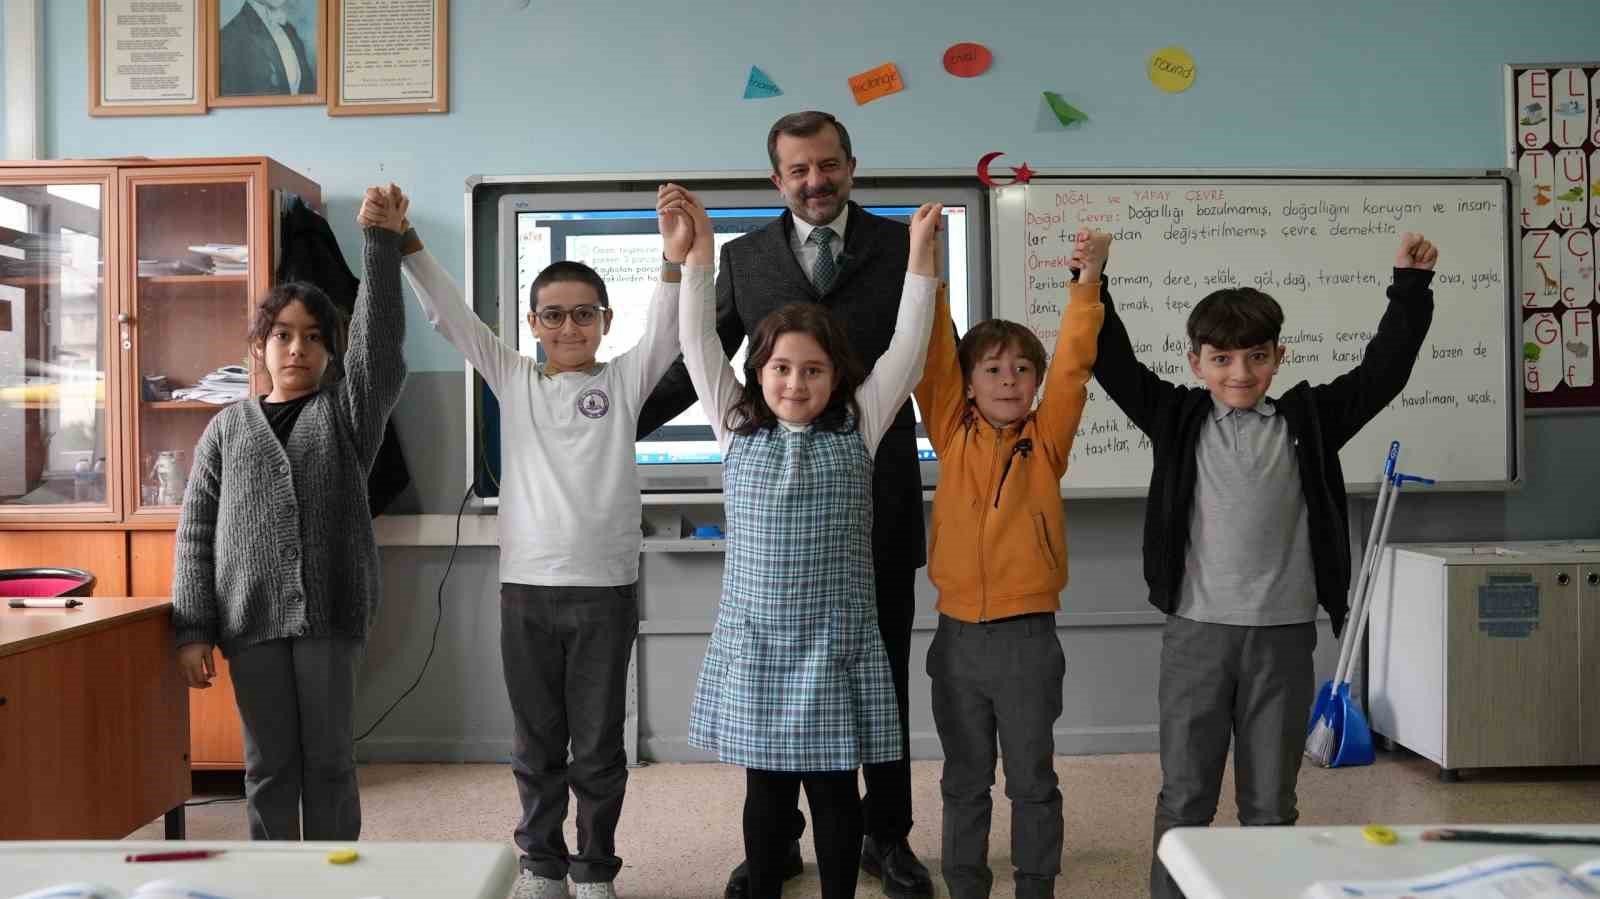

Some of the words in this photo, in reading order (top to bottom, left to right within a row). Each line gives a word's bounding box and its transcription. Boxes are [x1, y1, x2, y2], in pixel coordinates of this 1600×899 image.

[1152, 55, 1193, 80] round
[1530, 71, 1547, 99] E
[1568, 70, 1585, 98] L
[1525, 152, 1545, 179] T
[1134, 190, 1169, 202] YAPAY
[1027, 209, 1065, 230] Doğal
[1128, 202, 1184, 224] Doğallığı
[1282, 199, 1350, 221] doğallığını
[1362, 197, 1422, 220] koruyan
[1432, 203, 1446, 214] ve
[1028, 231, 1048, 247] lar
[1280, 225, 1318, 238] çevre
[1532, 232, 1551, 259] Z
[1163, 272, 1198, 288] dere,
[1574, 310, 1590, 337] F
